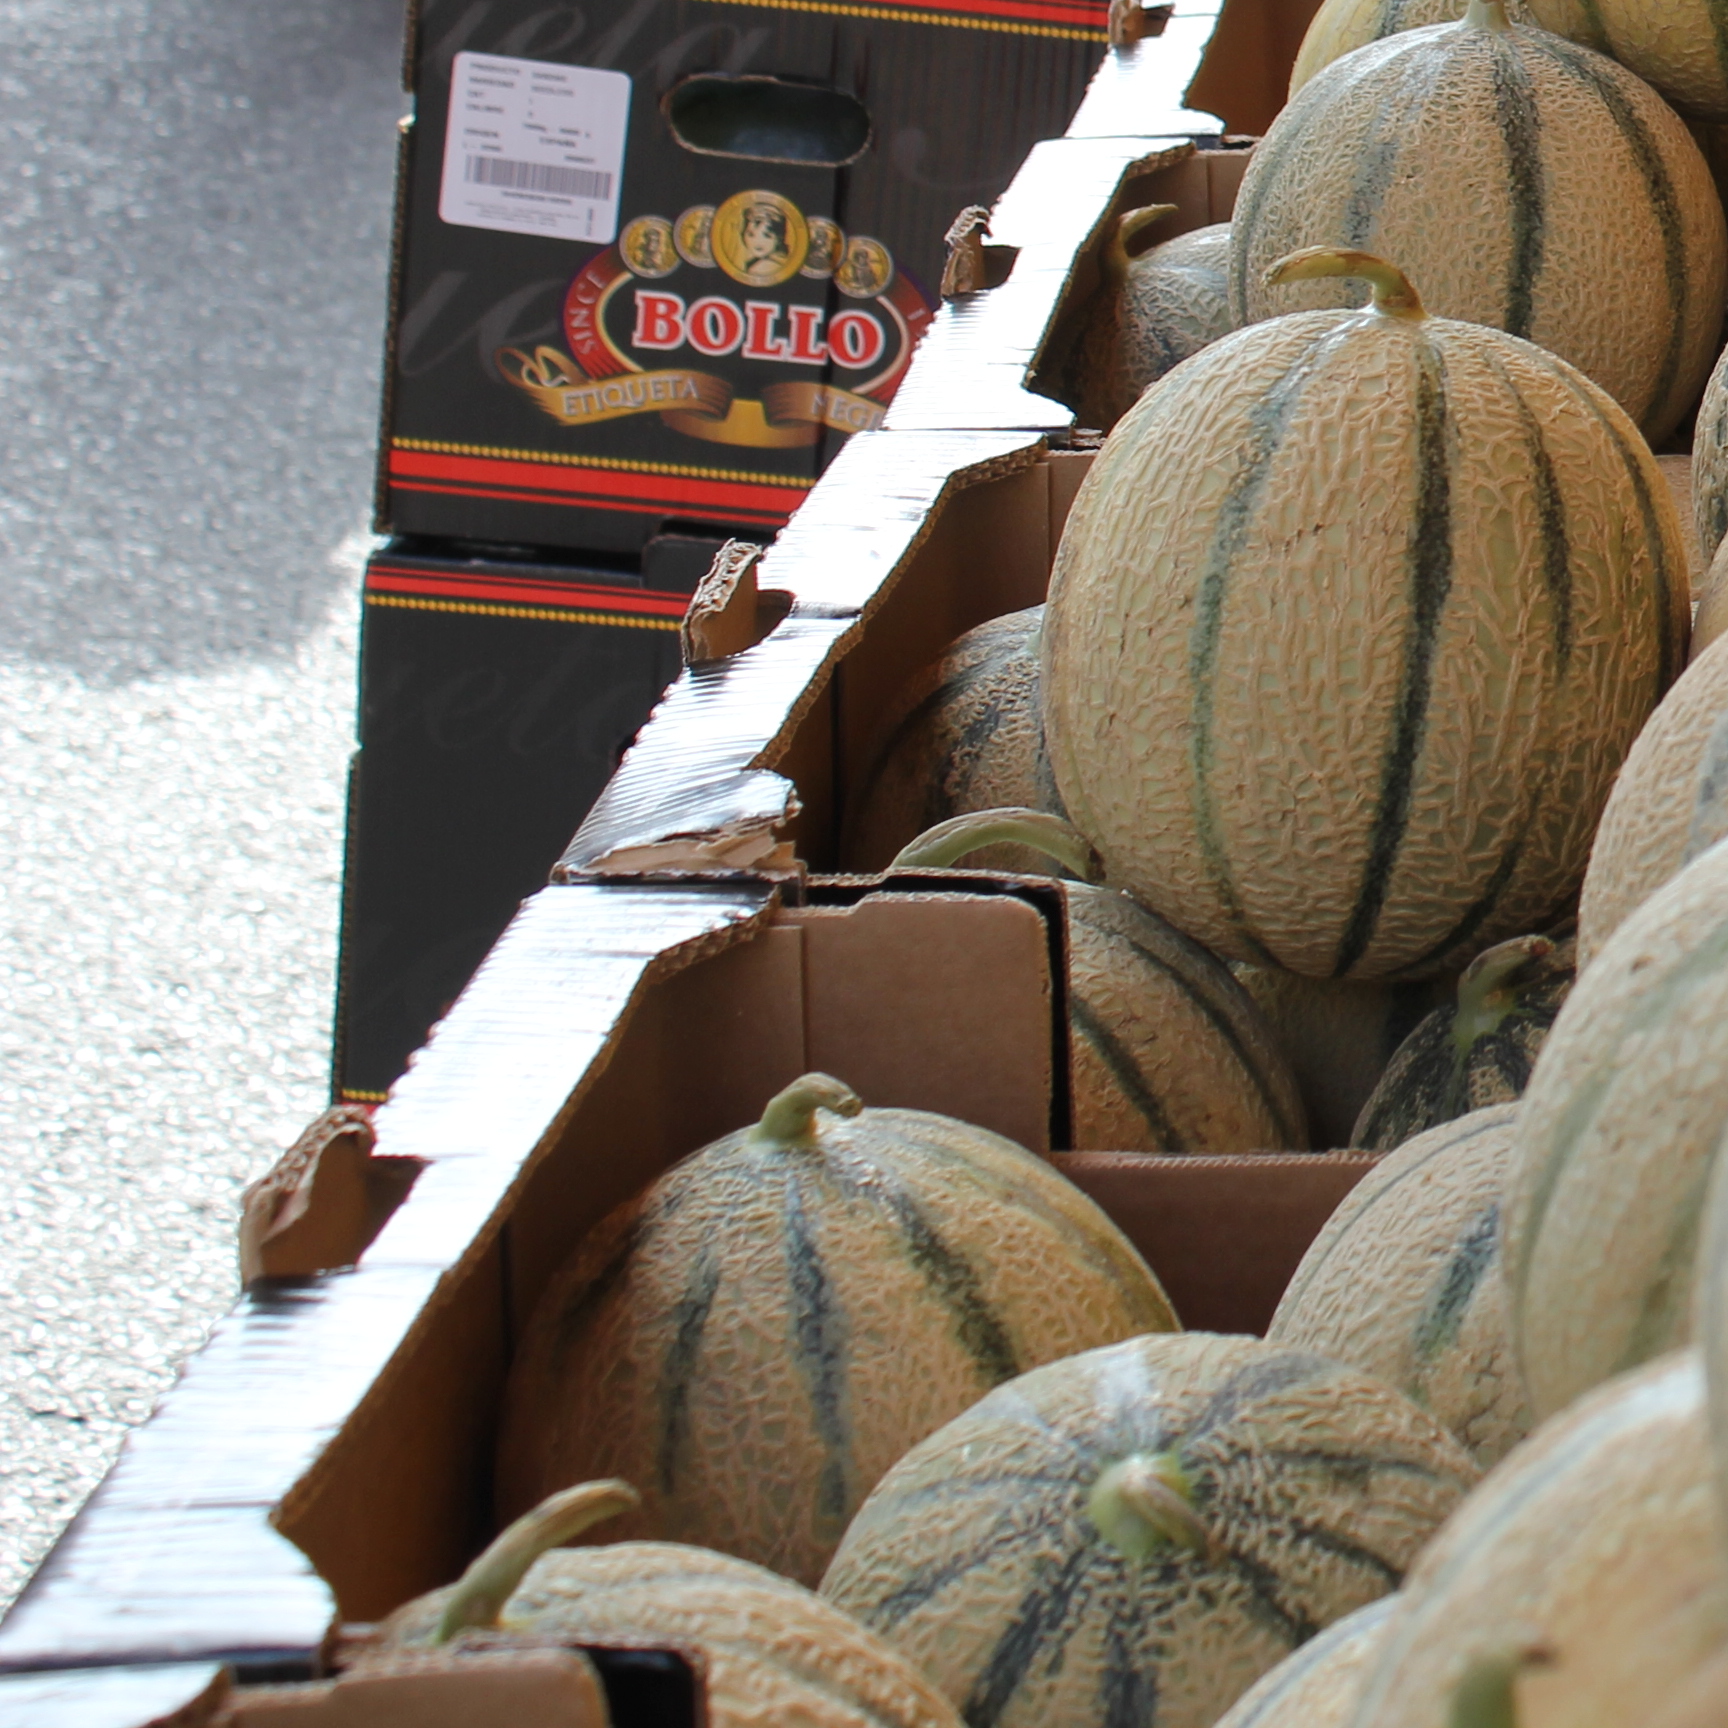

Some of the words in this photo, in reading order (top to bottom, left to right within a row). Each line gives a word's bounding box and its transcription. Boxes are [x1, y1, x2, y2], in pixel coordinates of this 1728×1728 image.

[568, 269, 609, 356] SINCE
[631, 290, 886, 369] BOLLO
[562, 375, 699, 417] ETIQUETA
